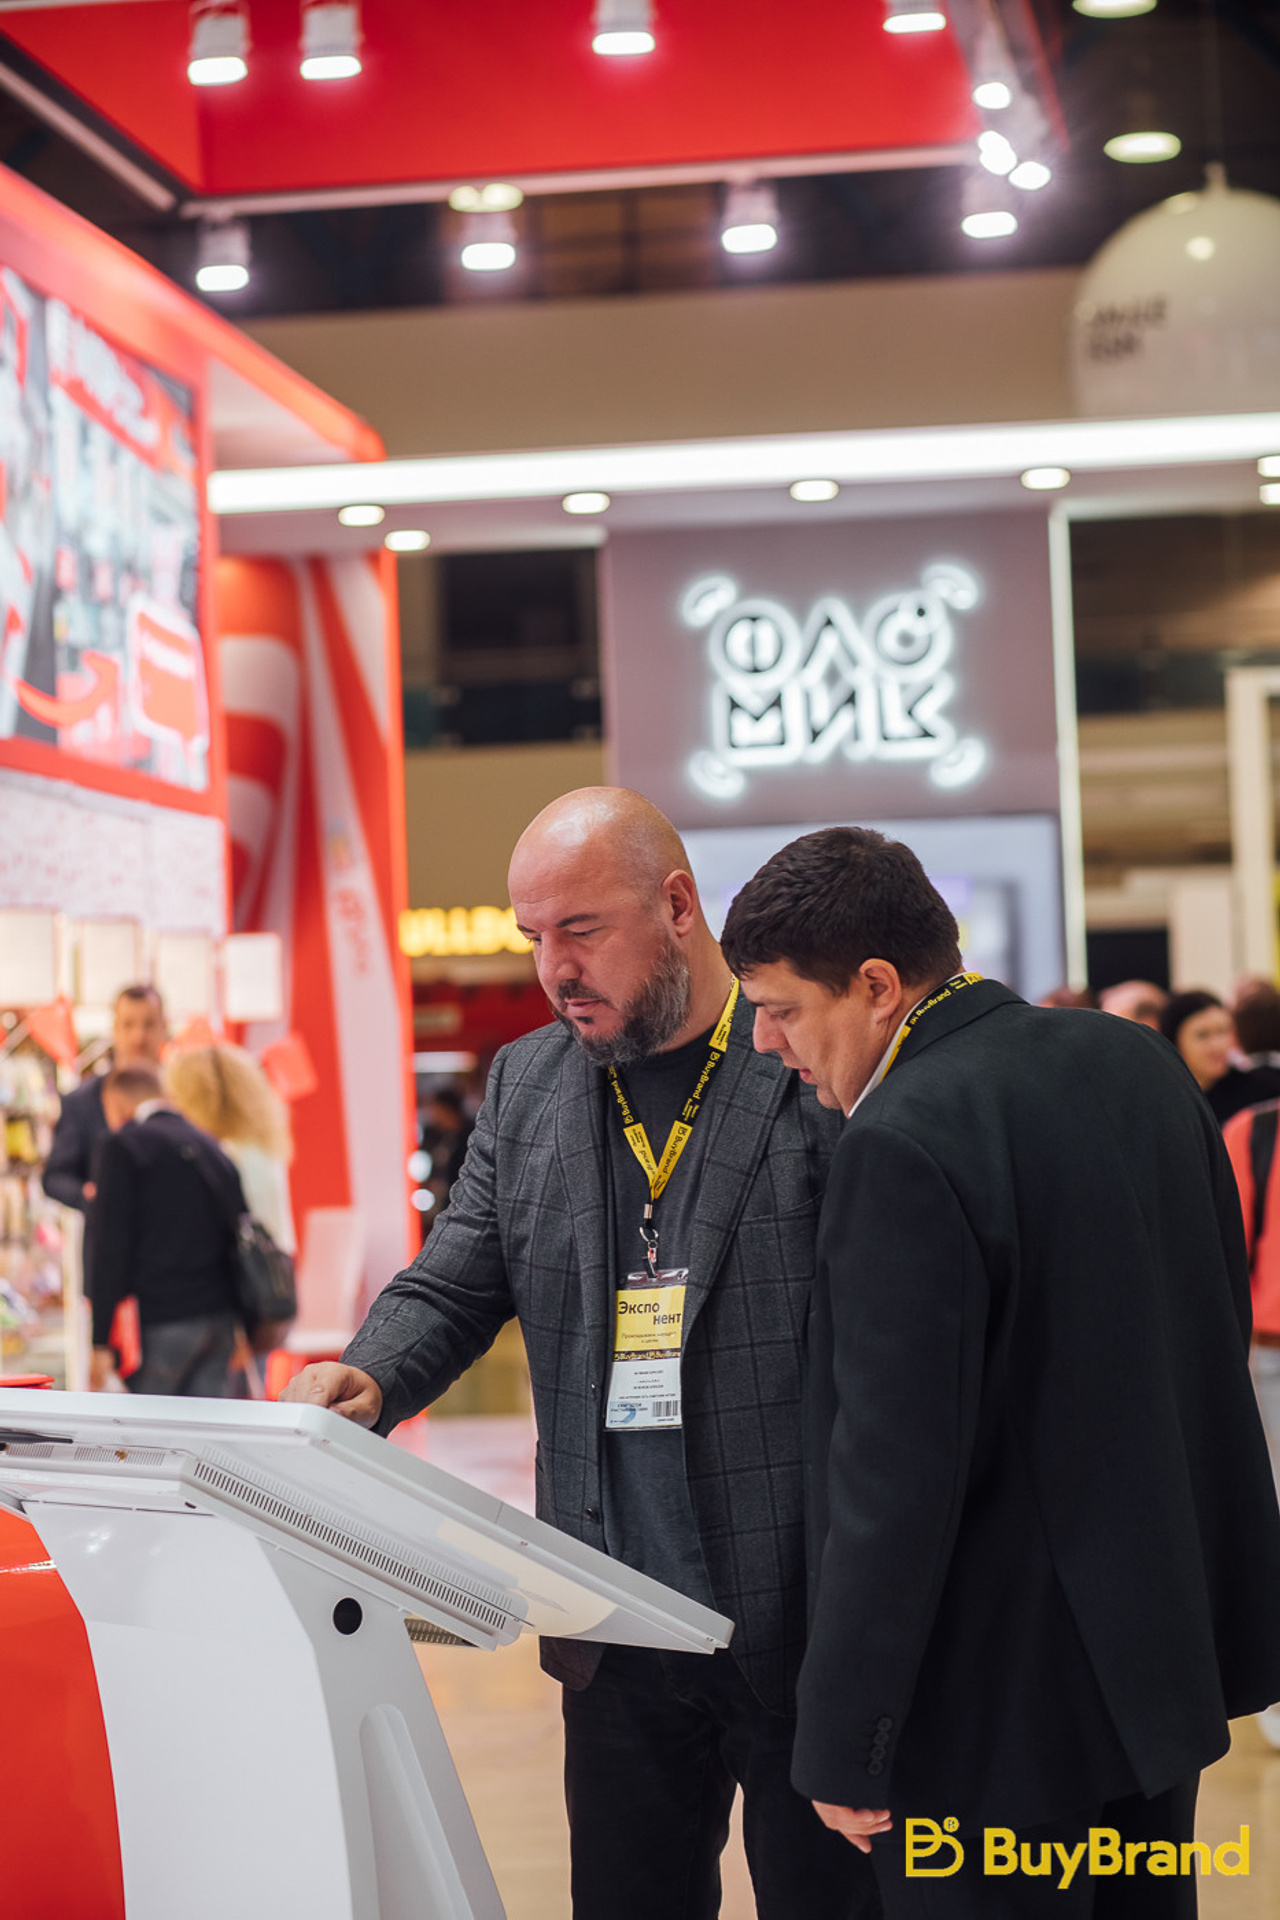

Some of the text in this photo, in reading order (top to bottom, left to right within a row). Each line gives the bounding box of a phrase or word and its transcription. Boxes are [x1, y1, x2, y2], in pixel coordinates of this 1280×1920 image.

[692, 1060, 715, 1099] BuyBrand
[611, 1080, 630, 1115] BuyBrand
[662, 1135, 683, 1174] BuyBrand
[618, 1301, 660, 1315] Экспо
[653, 1313, 682, 1325] нент
